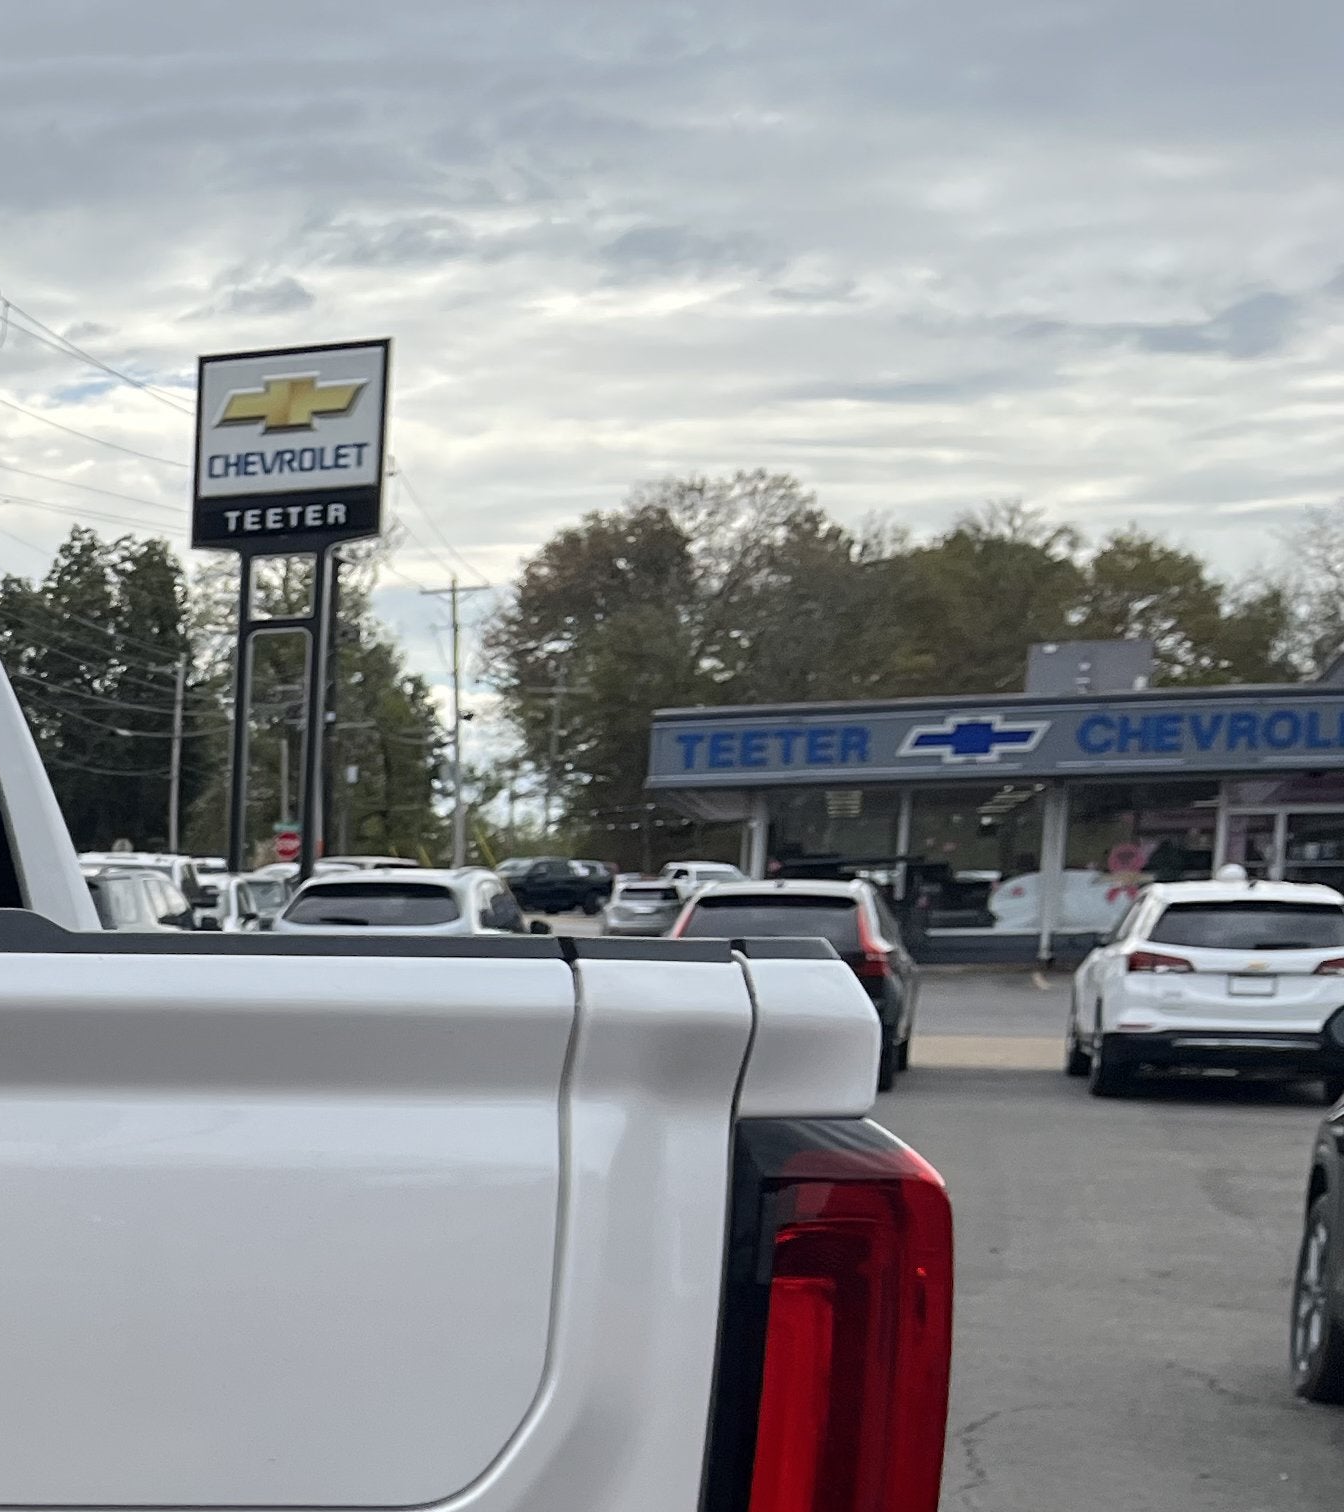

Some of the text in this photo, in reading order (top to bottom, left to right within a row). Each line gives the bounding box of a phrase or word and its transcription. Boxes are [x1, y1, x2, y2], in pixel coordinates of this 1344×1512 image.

[208, 443, 370, 478] CHEVROLET
[223, 503, 347, 532] TEETER
[676, 710, 1344, 769] TEETER CHEVROL
